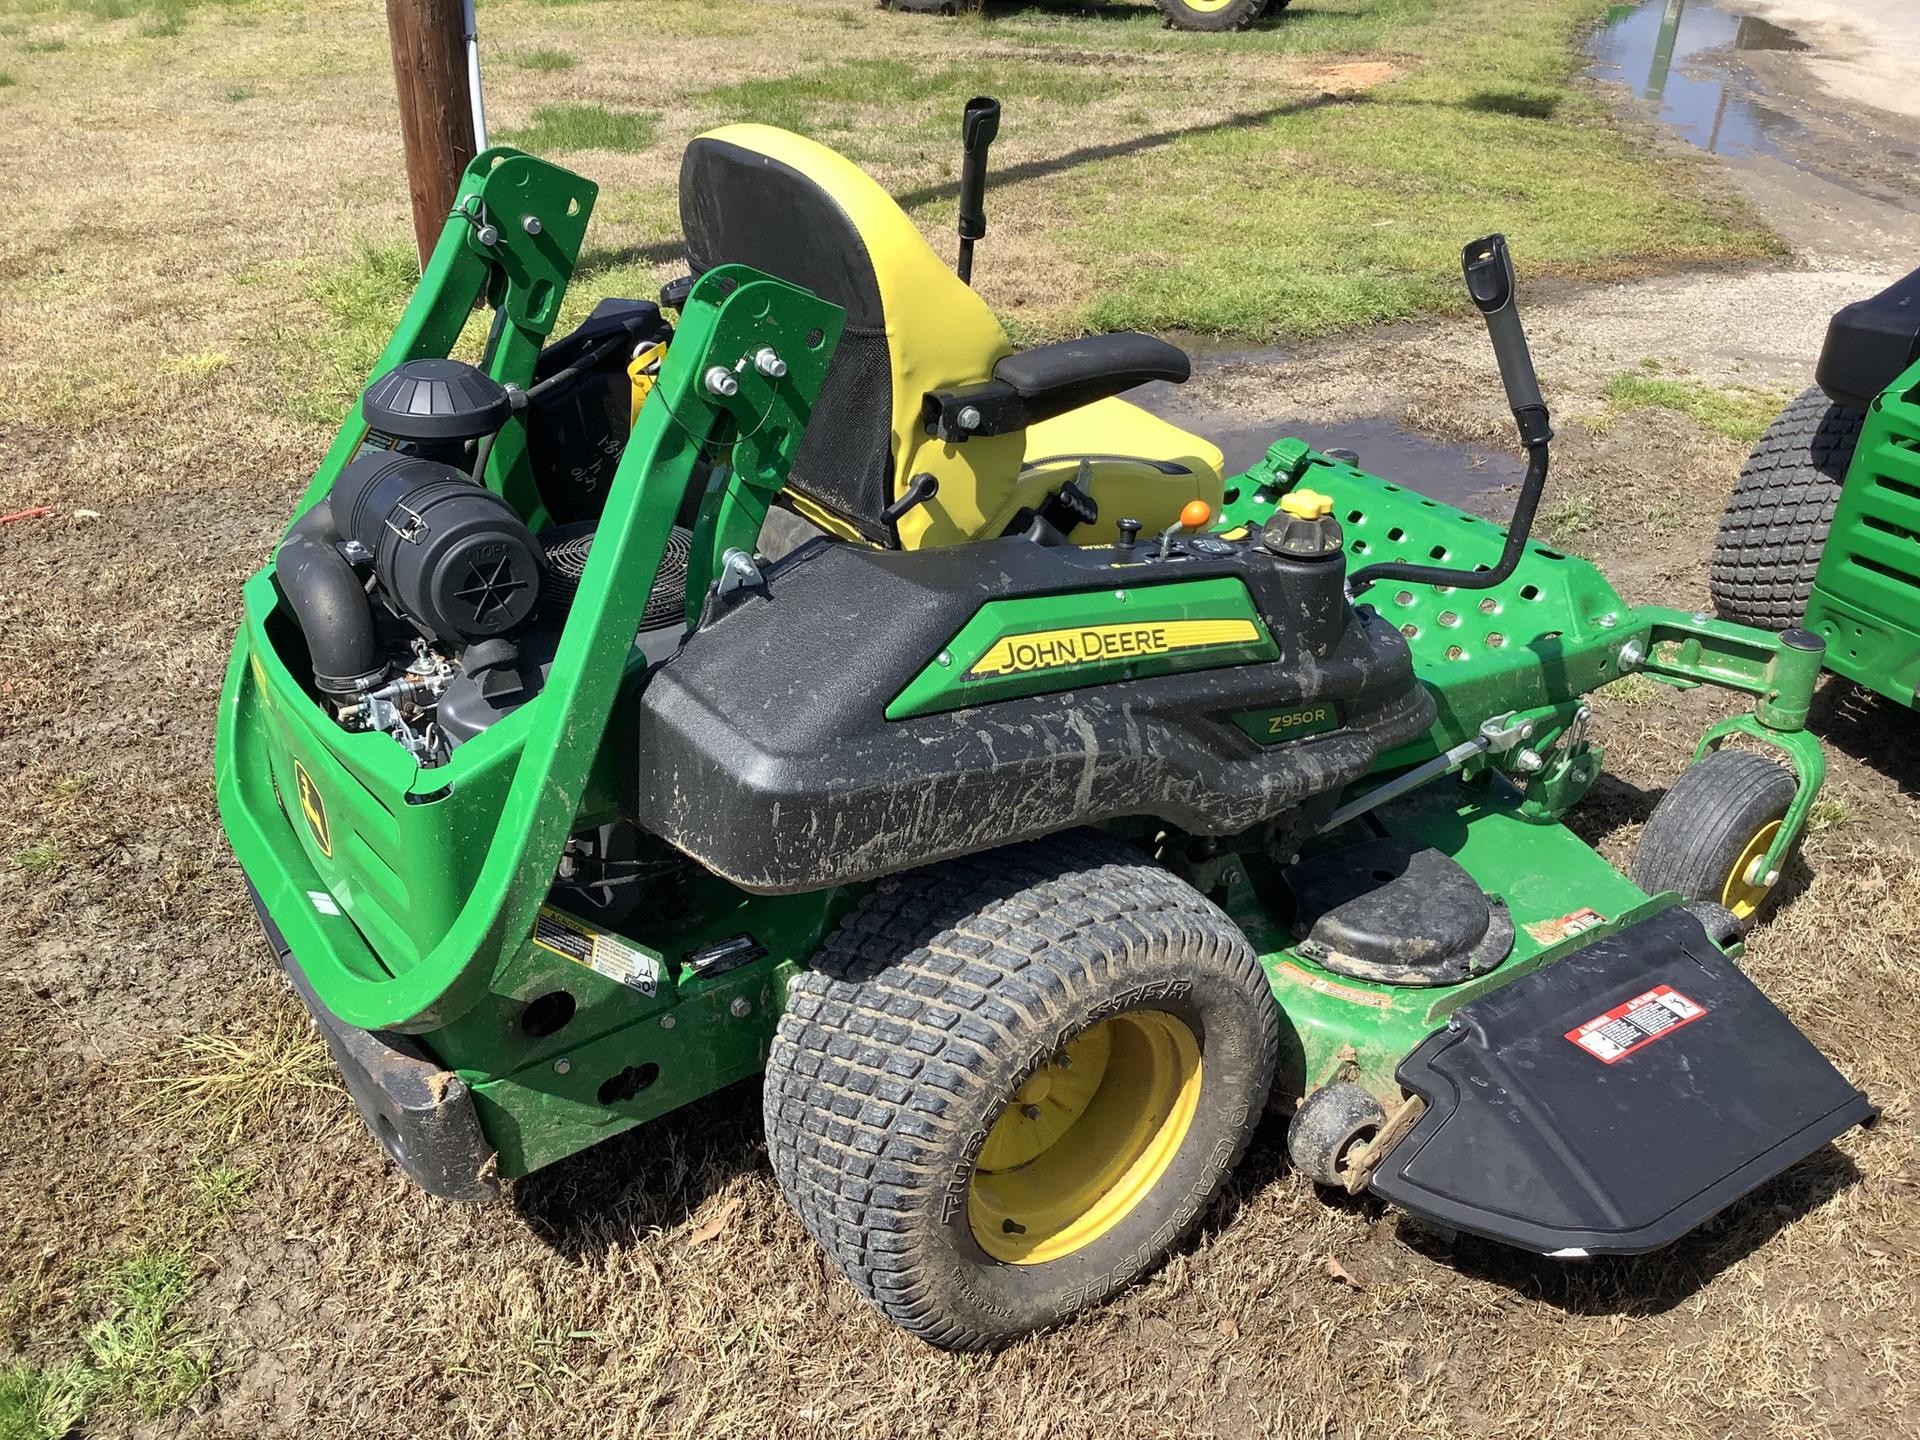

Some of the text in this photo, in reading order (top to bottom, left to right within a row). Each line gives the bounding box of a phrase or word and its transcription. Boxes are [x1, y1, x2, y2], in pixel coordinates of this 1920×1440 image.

[1000, 628, 1168, 670] JOHN DEERE
[1268, 709, 1325, 734] Z950R
[1057, 1137, 1238, 1317] CARLISLE
